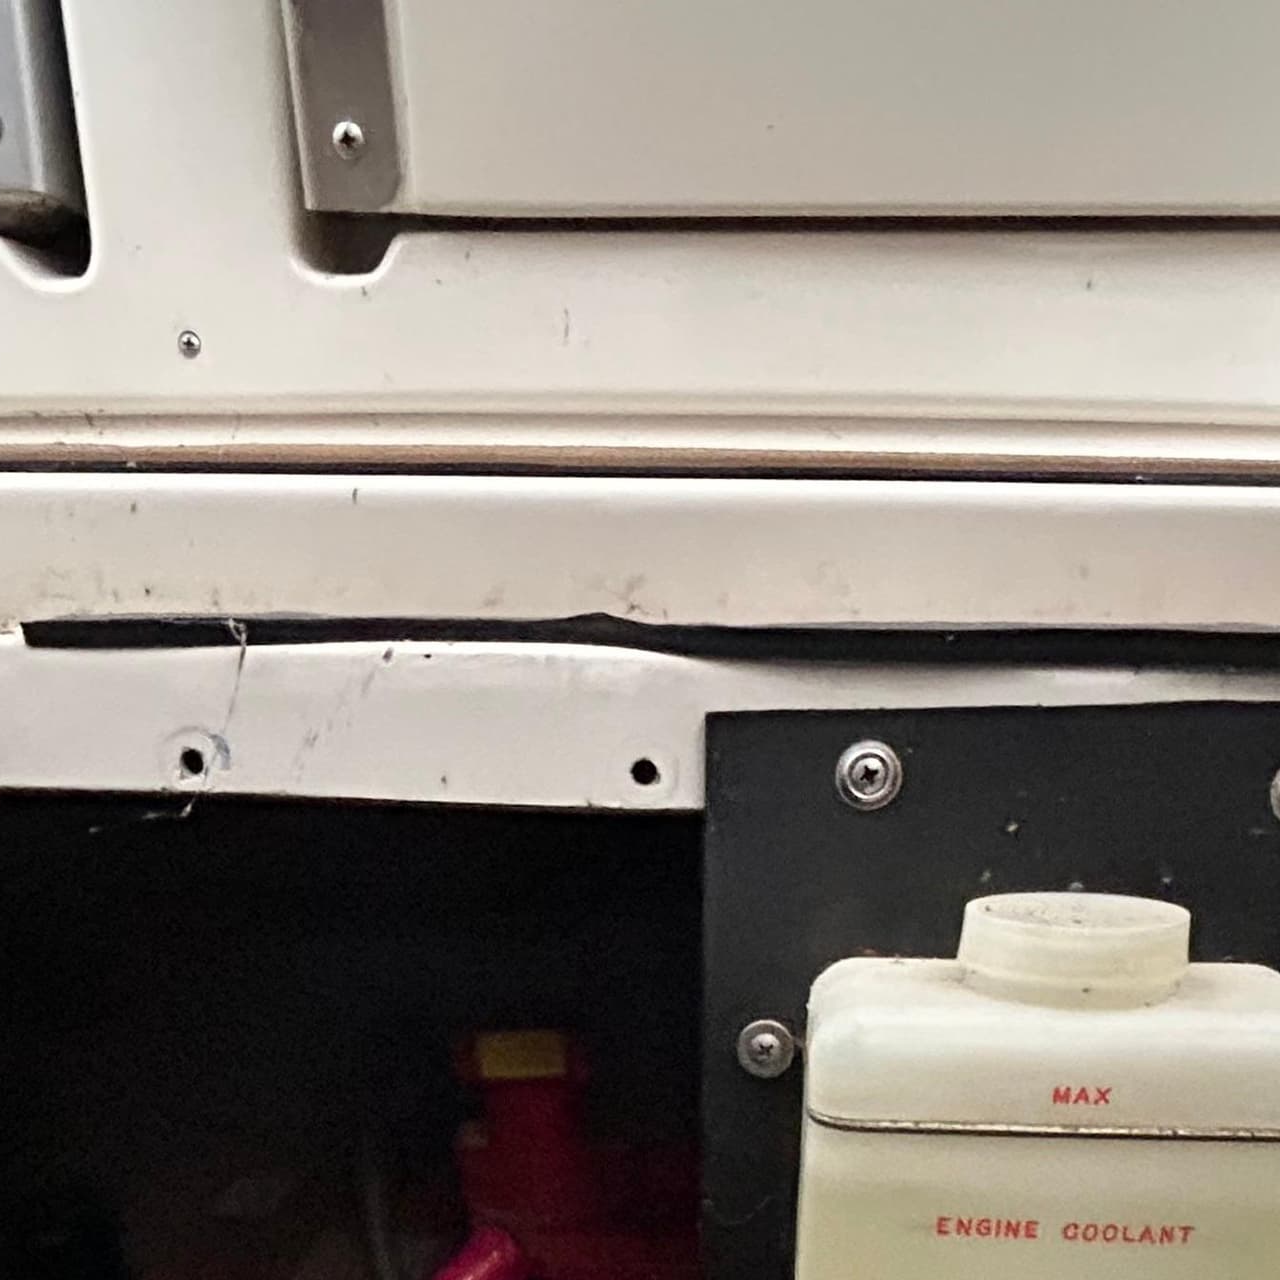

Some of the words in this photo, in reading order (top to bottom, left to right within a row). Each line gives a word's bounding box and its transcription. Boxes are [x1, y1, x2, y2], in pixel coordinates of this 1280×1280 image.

[1052, 1087, 1112, 1105] MAX
[936, 1217, 1038, 1239] ENGINE
[1063, 1224, 1195, 1244] COOLANT
